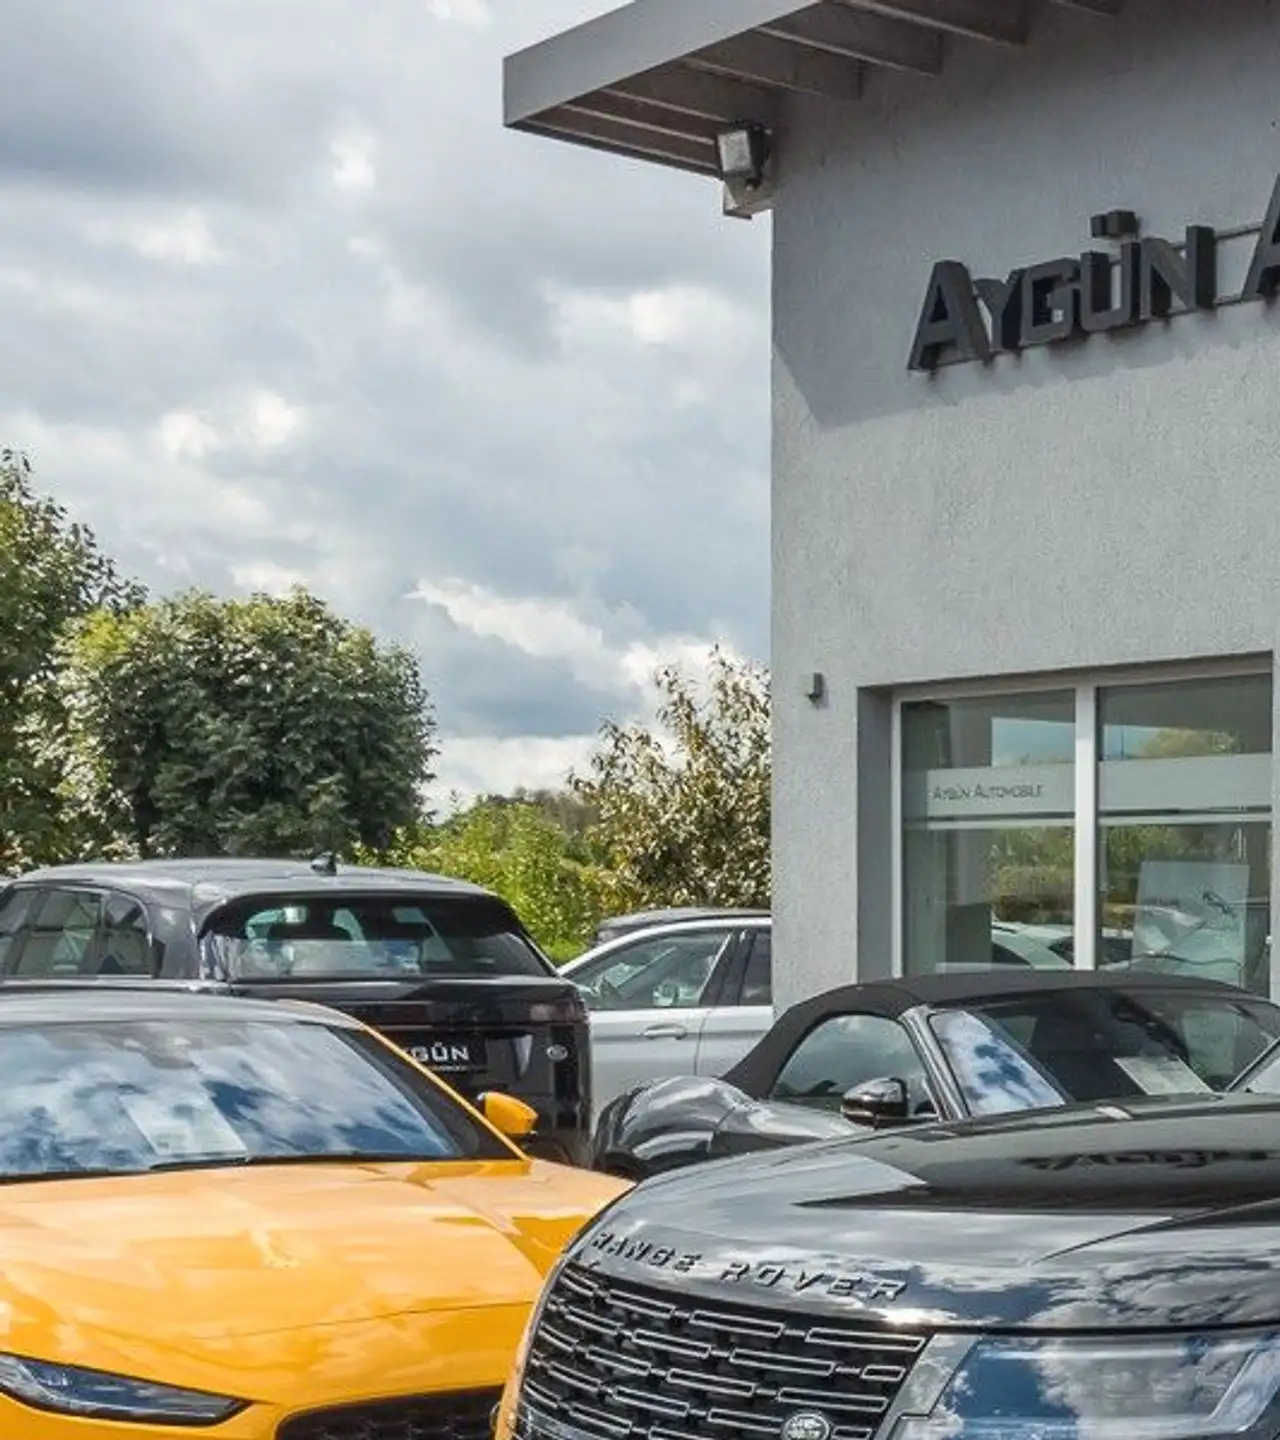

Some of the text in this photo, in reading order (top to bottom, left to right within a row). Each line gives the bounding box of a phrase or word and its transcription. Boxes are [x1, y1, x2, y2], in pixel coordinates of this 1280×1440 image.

[906, 209, 1215, 372] AYGÜN
[590, 1231, 908, 1302] RANGE ROVER
